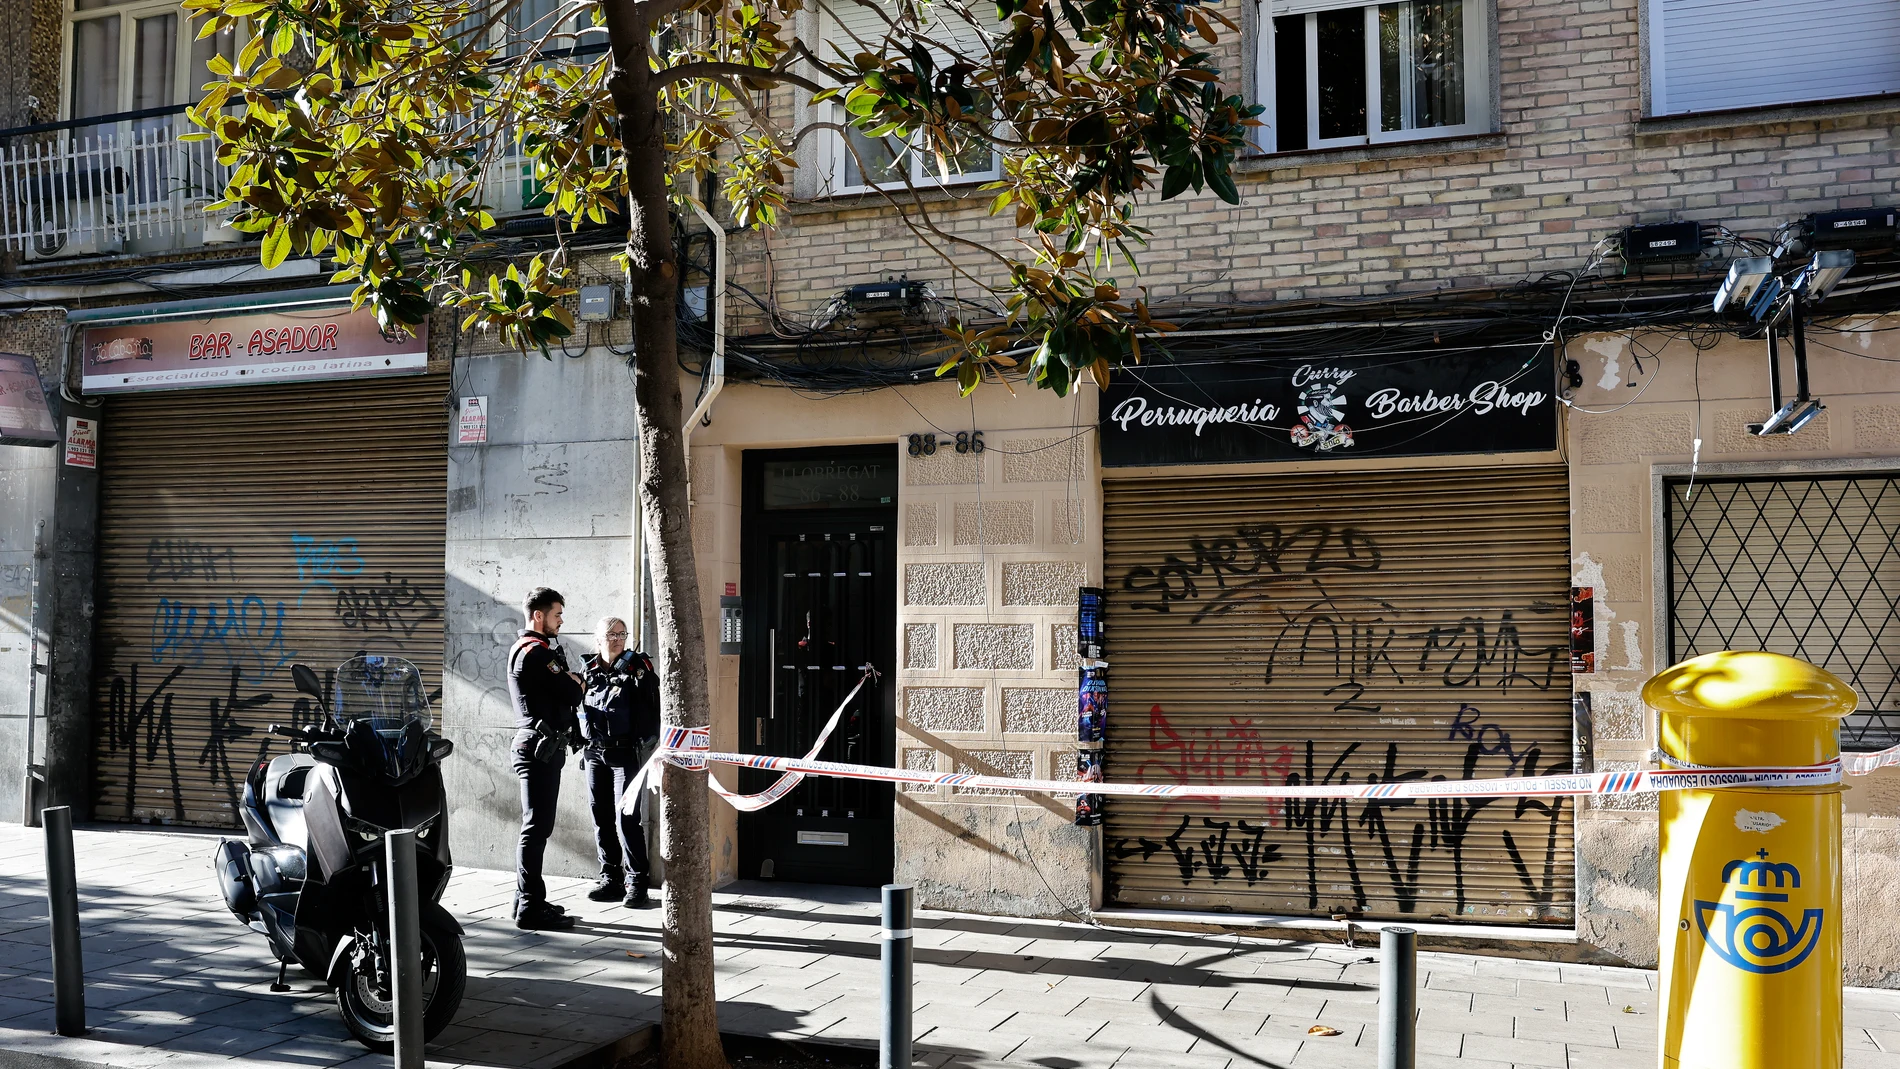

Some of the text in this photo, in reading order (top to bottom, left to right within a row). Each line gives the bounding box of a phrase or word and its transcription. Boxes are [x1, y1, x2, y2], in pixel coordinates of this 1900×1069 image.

[188, 331, 233, 361] BAR
[247, 322, 340, 356] ASADOR
[261, 364, 317, 374] cocina
[323, 360, 373, 370] latina
[1291, 363, 1357, 387] Curry
[1364, 380, 1547, 419] Barber Shop
[1111, 396, 1281, 437] Perruqueria
[907, 431, 985, 458] 88-86
[691, 734, 701, 747] NO
[1464, 782, 1498, 793] MOSSOS
[1506, 780, 1537, 791] POLICIA
[1544, 778, 1578, 790] PASSEU
[1579, 777, 1592, 790] NO
